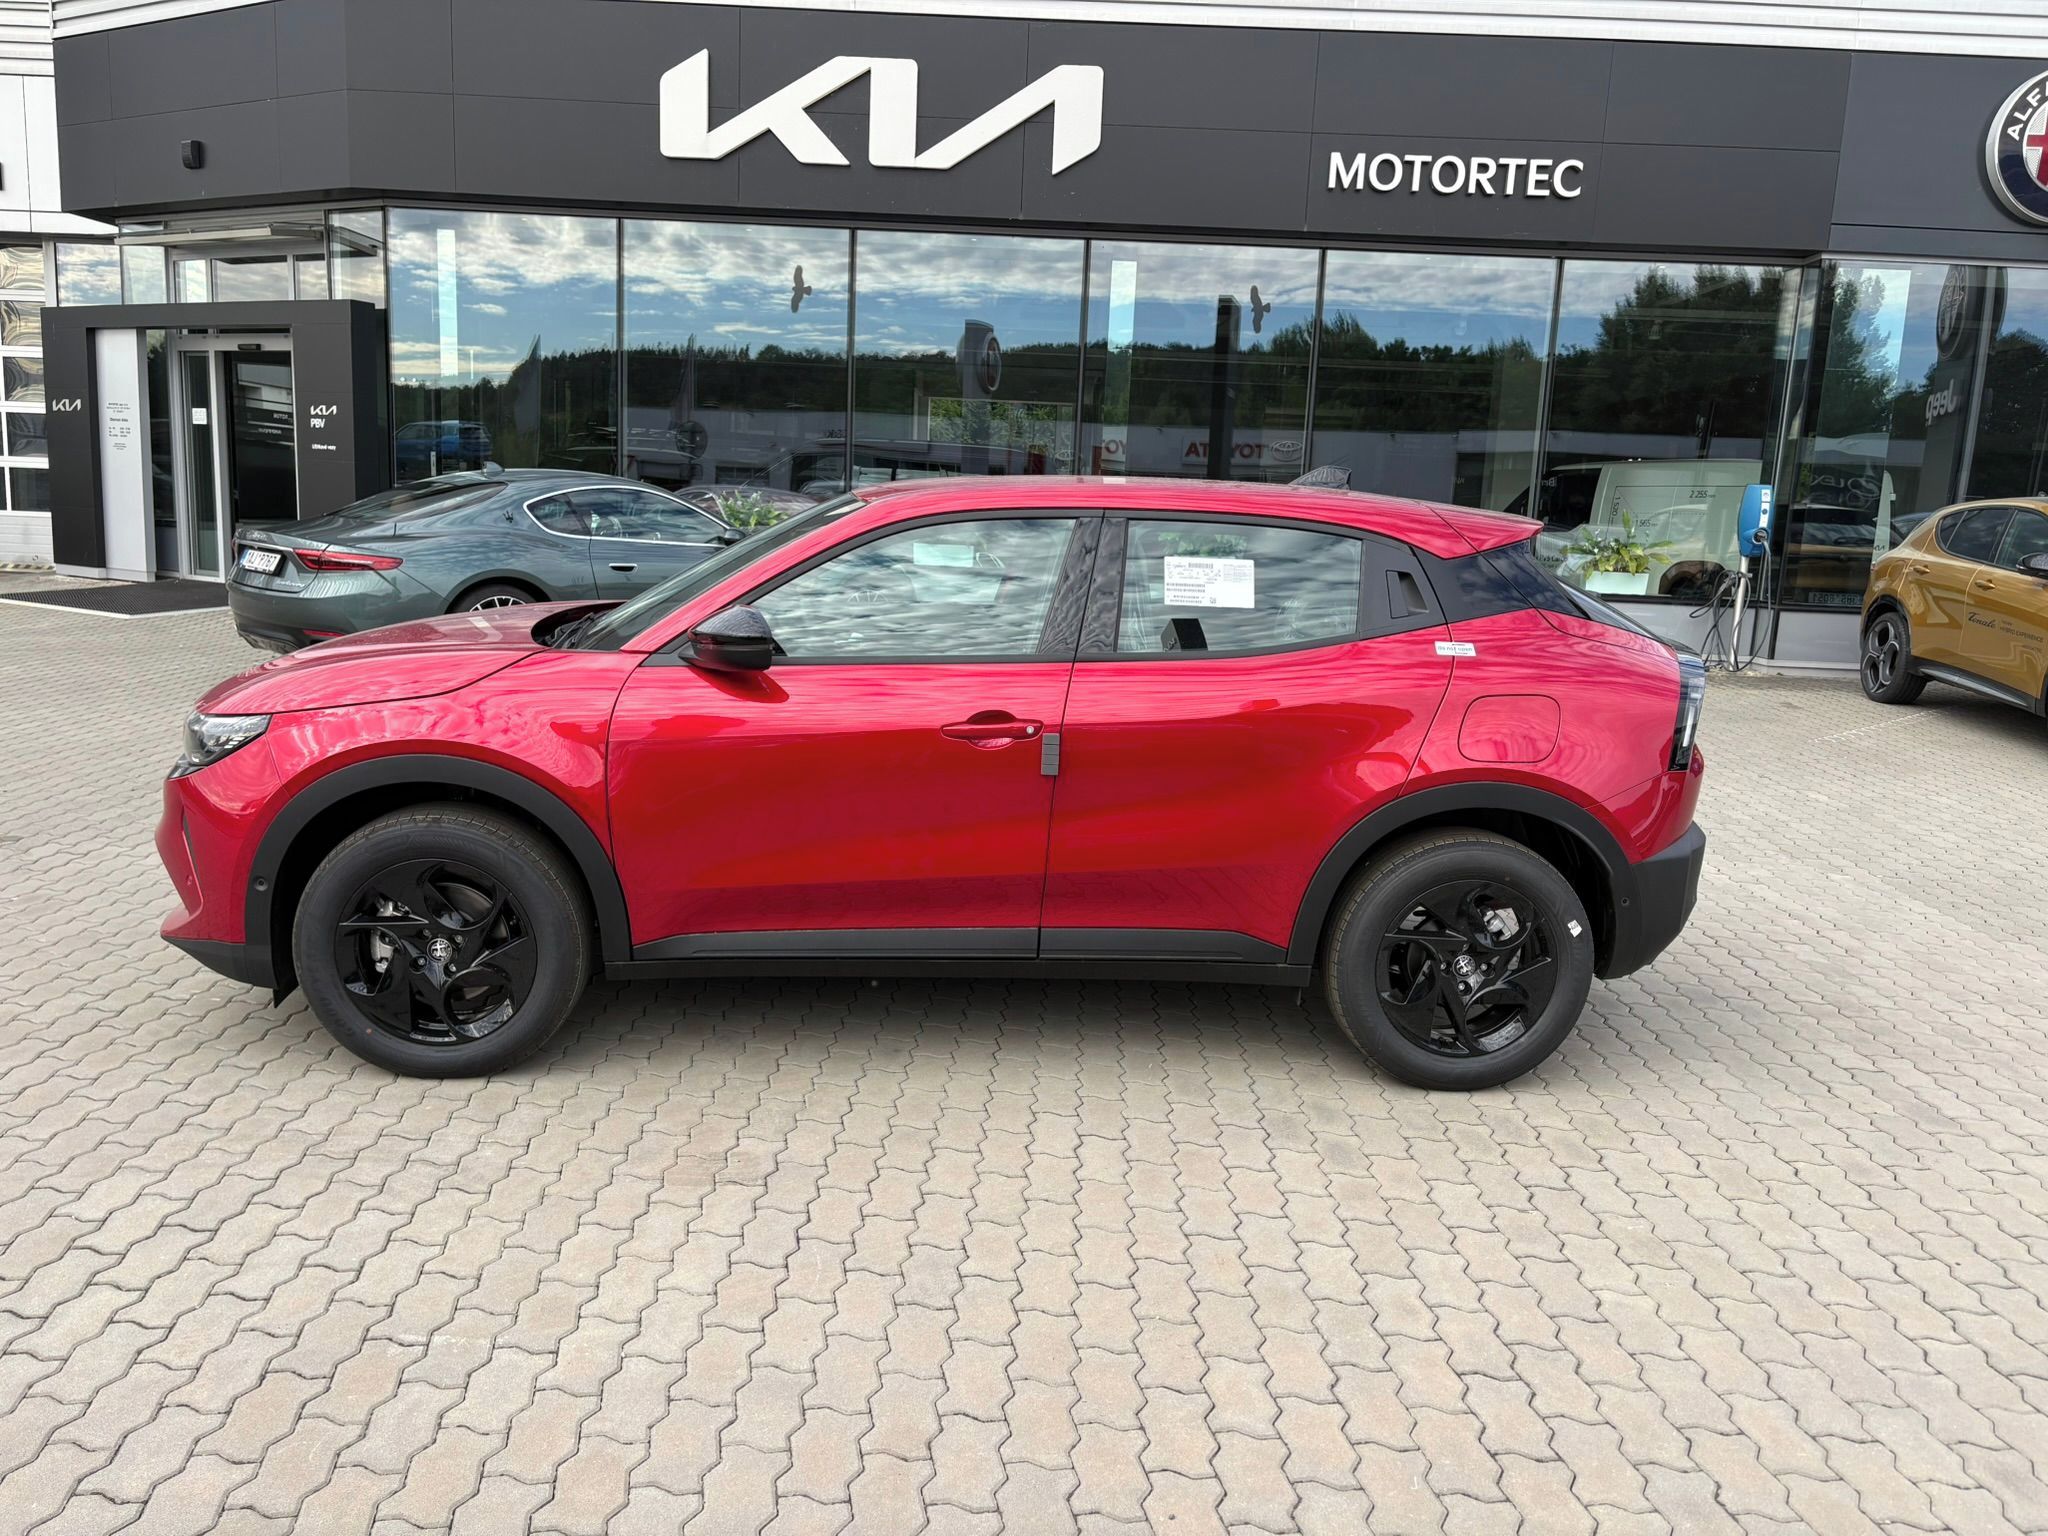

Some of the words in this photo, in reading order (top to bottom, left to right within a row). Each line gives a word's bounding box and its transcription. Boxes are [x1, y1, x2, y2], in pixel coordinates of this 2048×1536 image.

[659, 48, 1104, 176] KIA
[2006, 80, 2048, 142] ALF
[1327, 151, 1585, 198] MOTORTEC
[52, 398, 82, 412] KIA
[310, 404, 337, 416] KIA
[310, 418, 326, 428] PBV
[1968, 611, 1996, 628] Tonale
